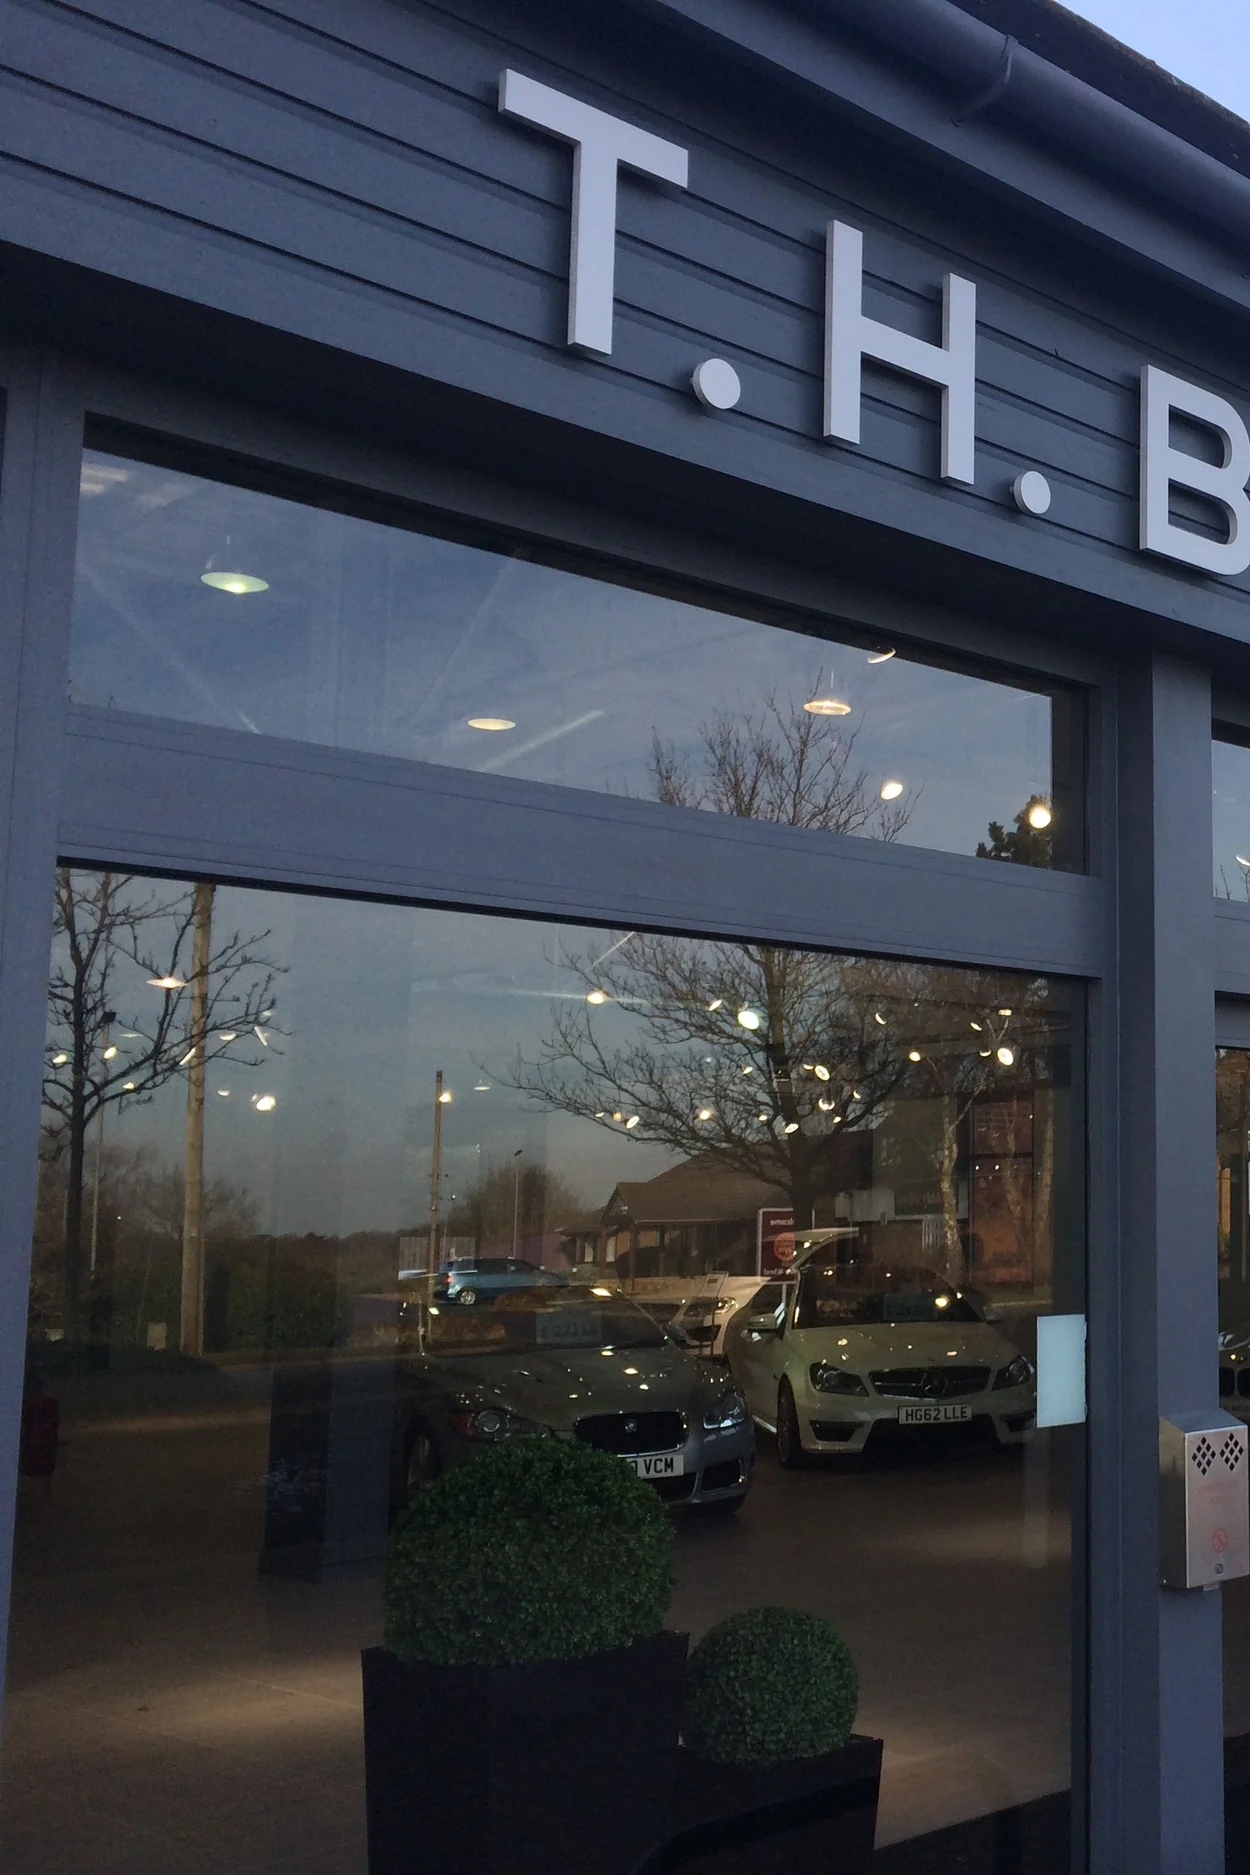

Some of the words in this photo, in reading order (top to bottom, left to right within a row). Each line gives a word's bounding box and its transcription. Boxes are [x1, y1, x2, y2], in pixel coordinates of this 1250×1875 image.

[905, 1407, 941, 1422] HG62
[943, 1405, 969, 1420] LLE
[643, 1456, 675, 1475] VCM
